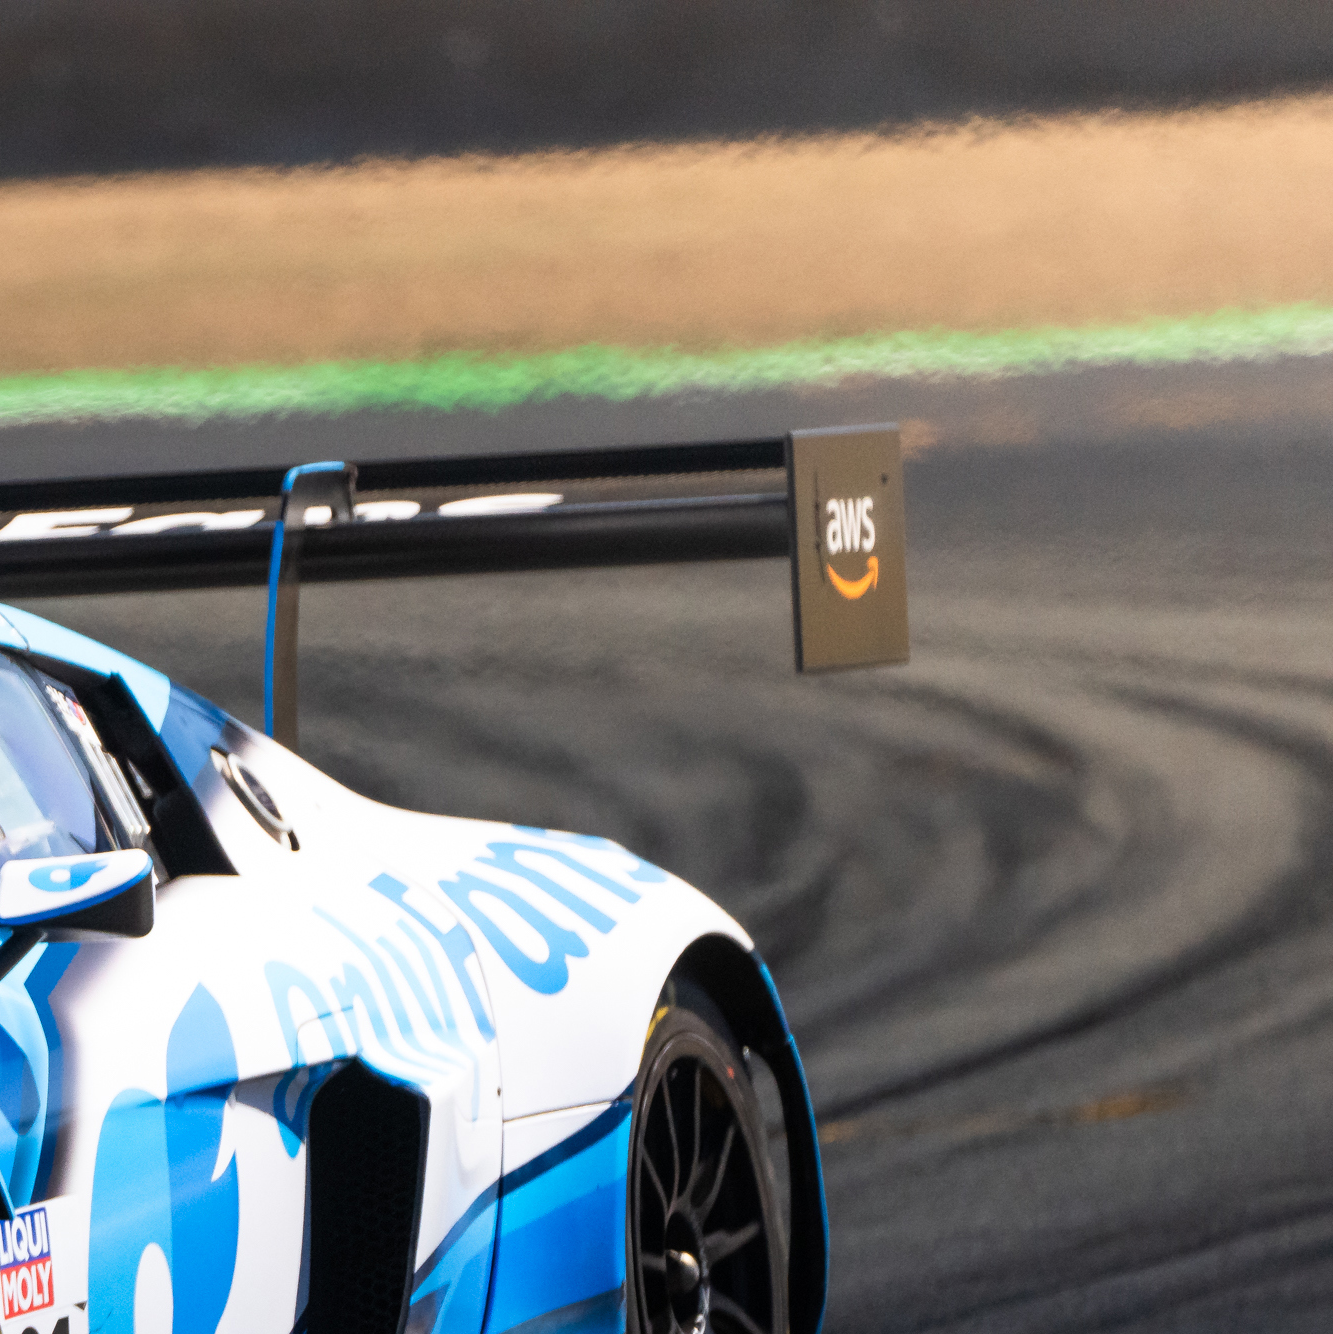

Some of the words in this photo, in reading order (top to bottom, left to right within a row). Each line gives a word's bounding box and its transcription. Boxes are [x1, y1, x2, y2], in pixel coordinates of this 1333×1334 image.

[826, 496, 876, 556] aws
[264, 825, 669, 1158] OnlyFans
[1, 1260, 52, 1317] MOLY
